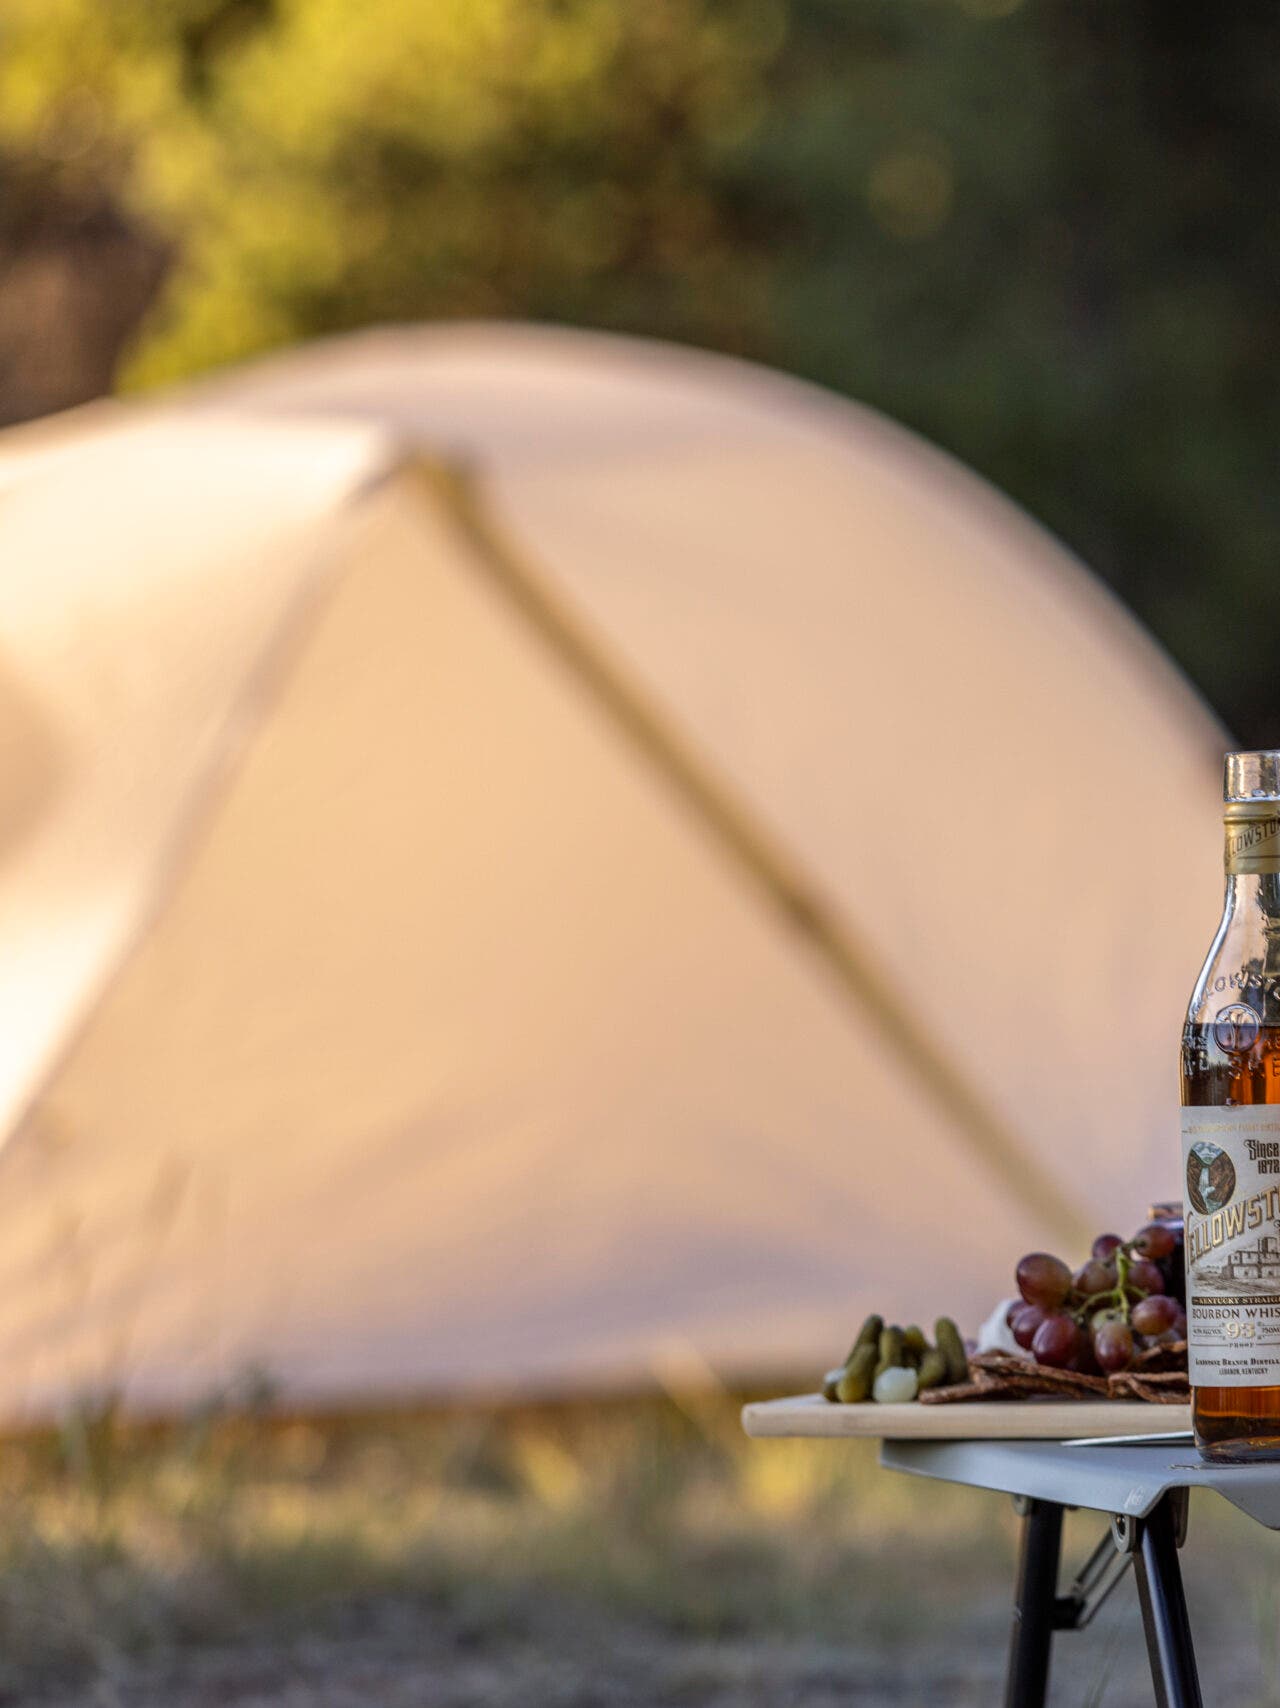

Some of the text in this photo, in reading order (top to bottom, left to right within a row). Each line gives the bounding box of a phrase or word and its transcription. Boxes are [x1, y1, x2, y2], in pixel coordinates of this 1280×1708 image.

[1244, 1139, 1279, 1160] Since
[1258, 1159, 1280, 1174] 1872
[1199, 1296, 1240, 1305] KENTUCKY
[1192, 1308, 1240, 1319] BOURBON
[1226, 1321, 1256, 1339] 93
